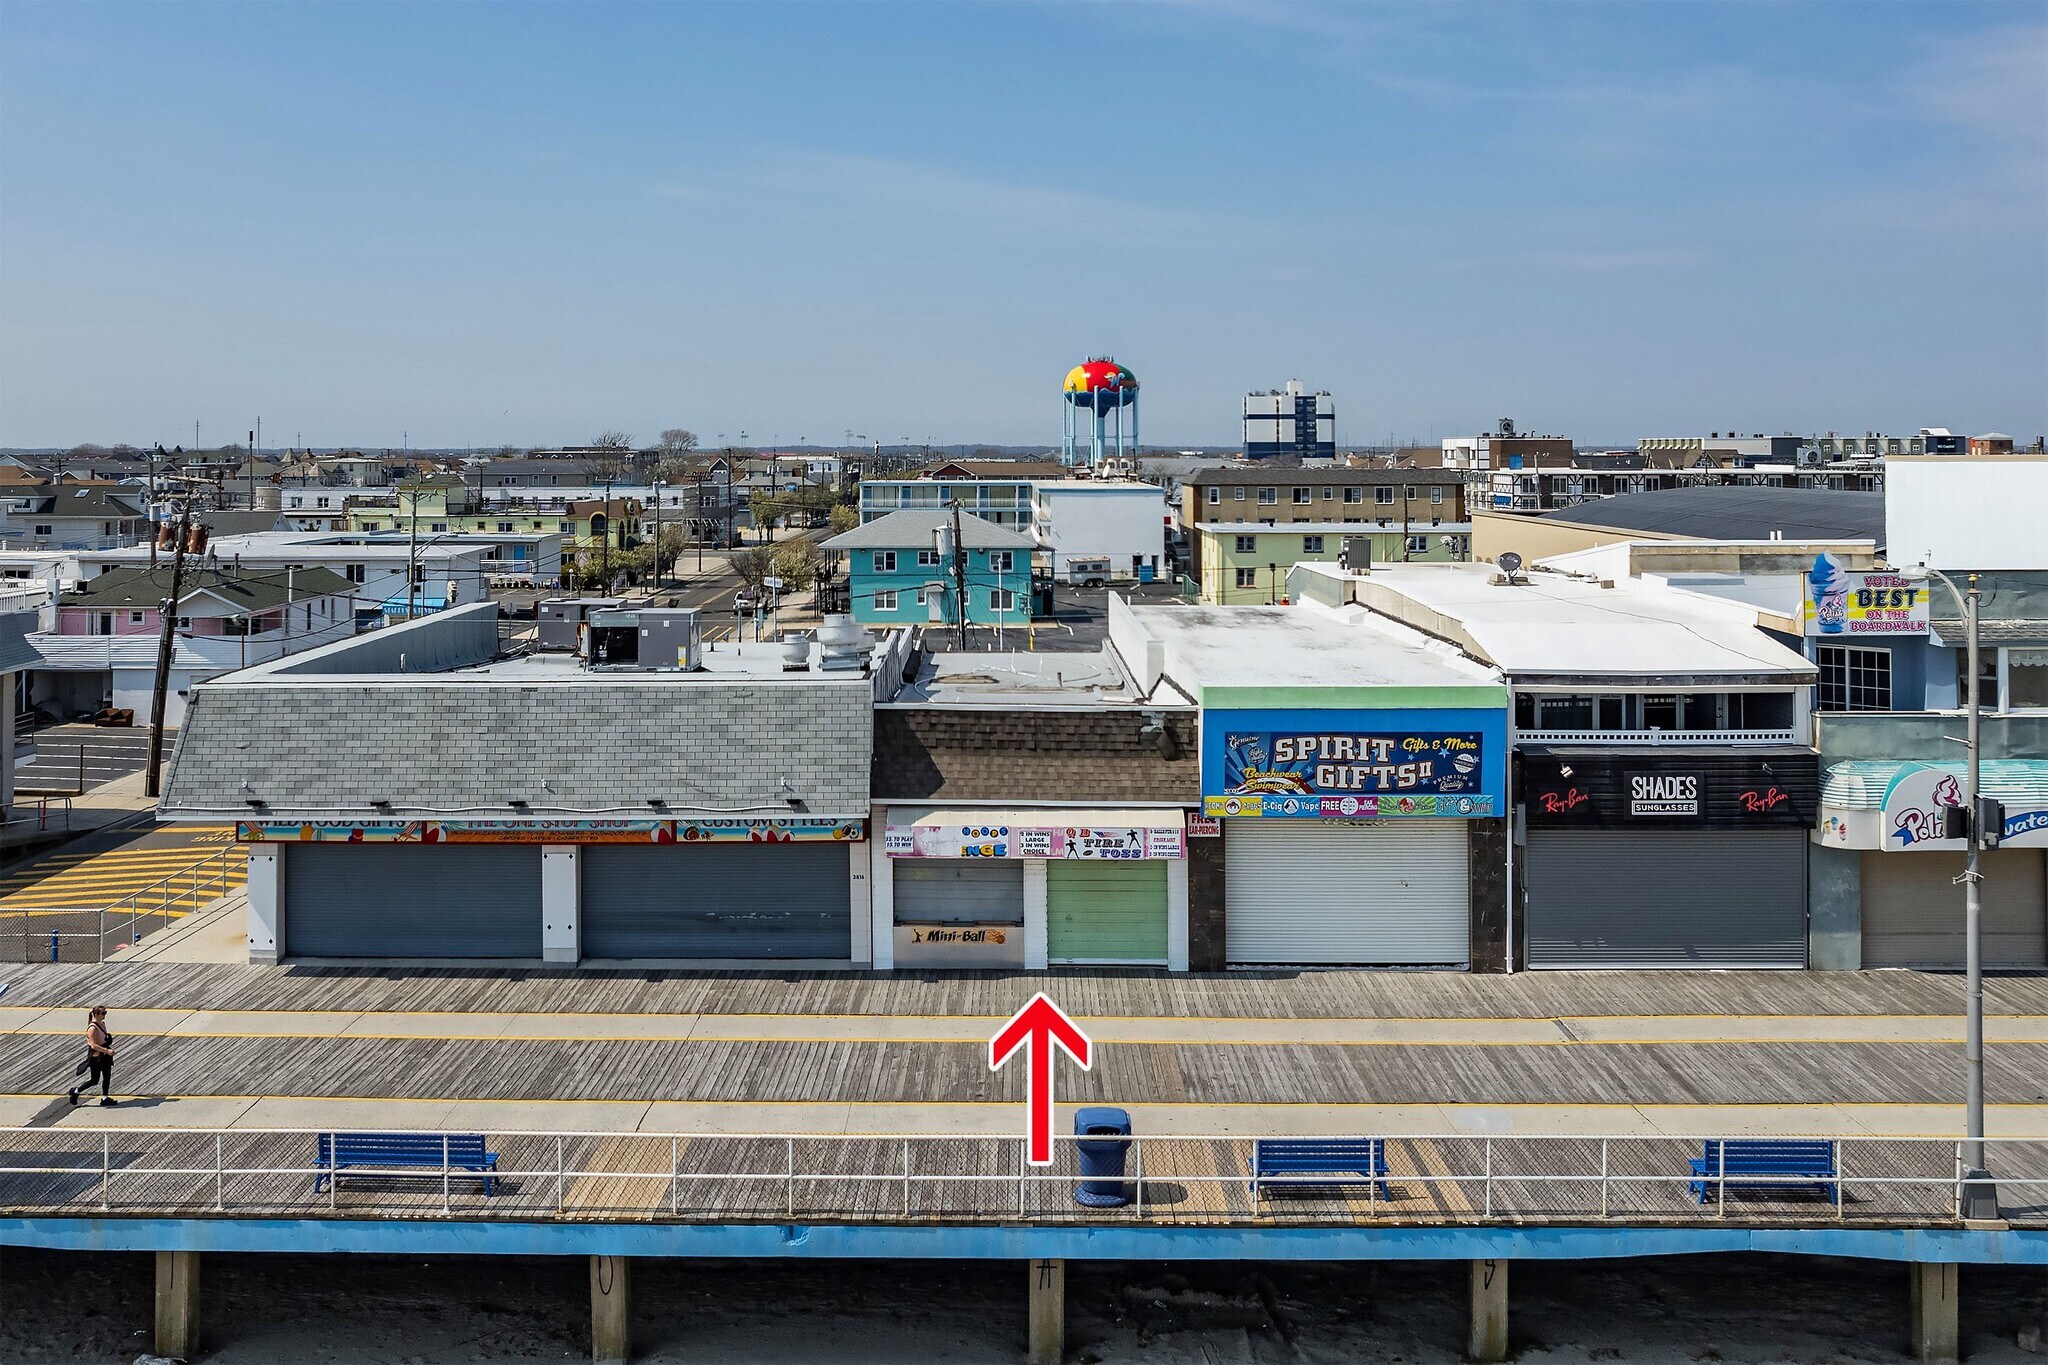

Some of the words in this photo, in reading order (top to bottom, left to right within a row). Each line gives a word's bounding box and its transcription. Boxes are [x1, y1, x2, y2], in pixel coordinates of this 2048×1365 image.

[764, 578, 782, 587] PARING
[1863, 575, 1911, 587] VOTED
[1855, 587, 1920, 608] BEST
[1865, 609, 1883, 620] ON
[1885, 609, 1910, 620] THE
[1849, 620, 1927, 633] BOARDWALK
[1275, 736, 1396, 763] SPIRIT
[1402, 737, 1430, 753] Gifts
[1432, 739, 1441, 750] &
[1443, 737, 1478, 751] More
[1242, 766, 1303, 779] Beachwear
[1245, 778, 1301, 791] Swimwear
[1433, 774, 1468, 785] PREMIUM
[1631, 776, 1697, 799] SHADES
[1320, 800, 1340, 811] FREE
[1539, 788, 1589, 813] Ray-Ban
[1739, 787, 1788, 812] Ray-Ban
[1301, 801, 1319, 812] Vape
[1635, 804, 1695, 812] SUNGLASSES
[1191, 814, 1217, 824] FREE
[961, 826, 1008, 838] HOOPS
[1066, 827, 1077, 839] Q
[1079, 828, 1091, 838] B
[1083, 838, 1124, 848] TIRE
[1099, 848, 1142, 859] TOSS
[927, 929, 986, 943] Mini-Ball
